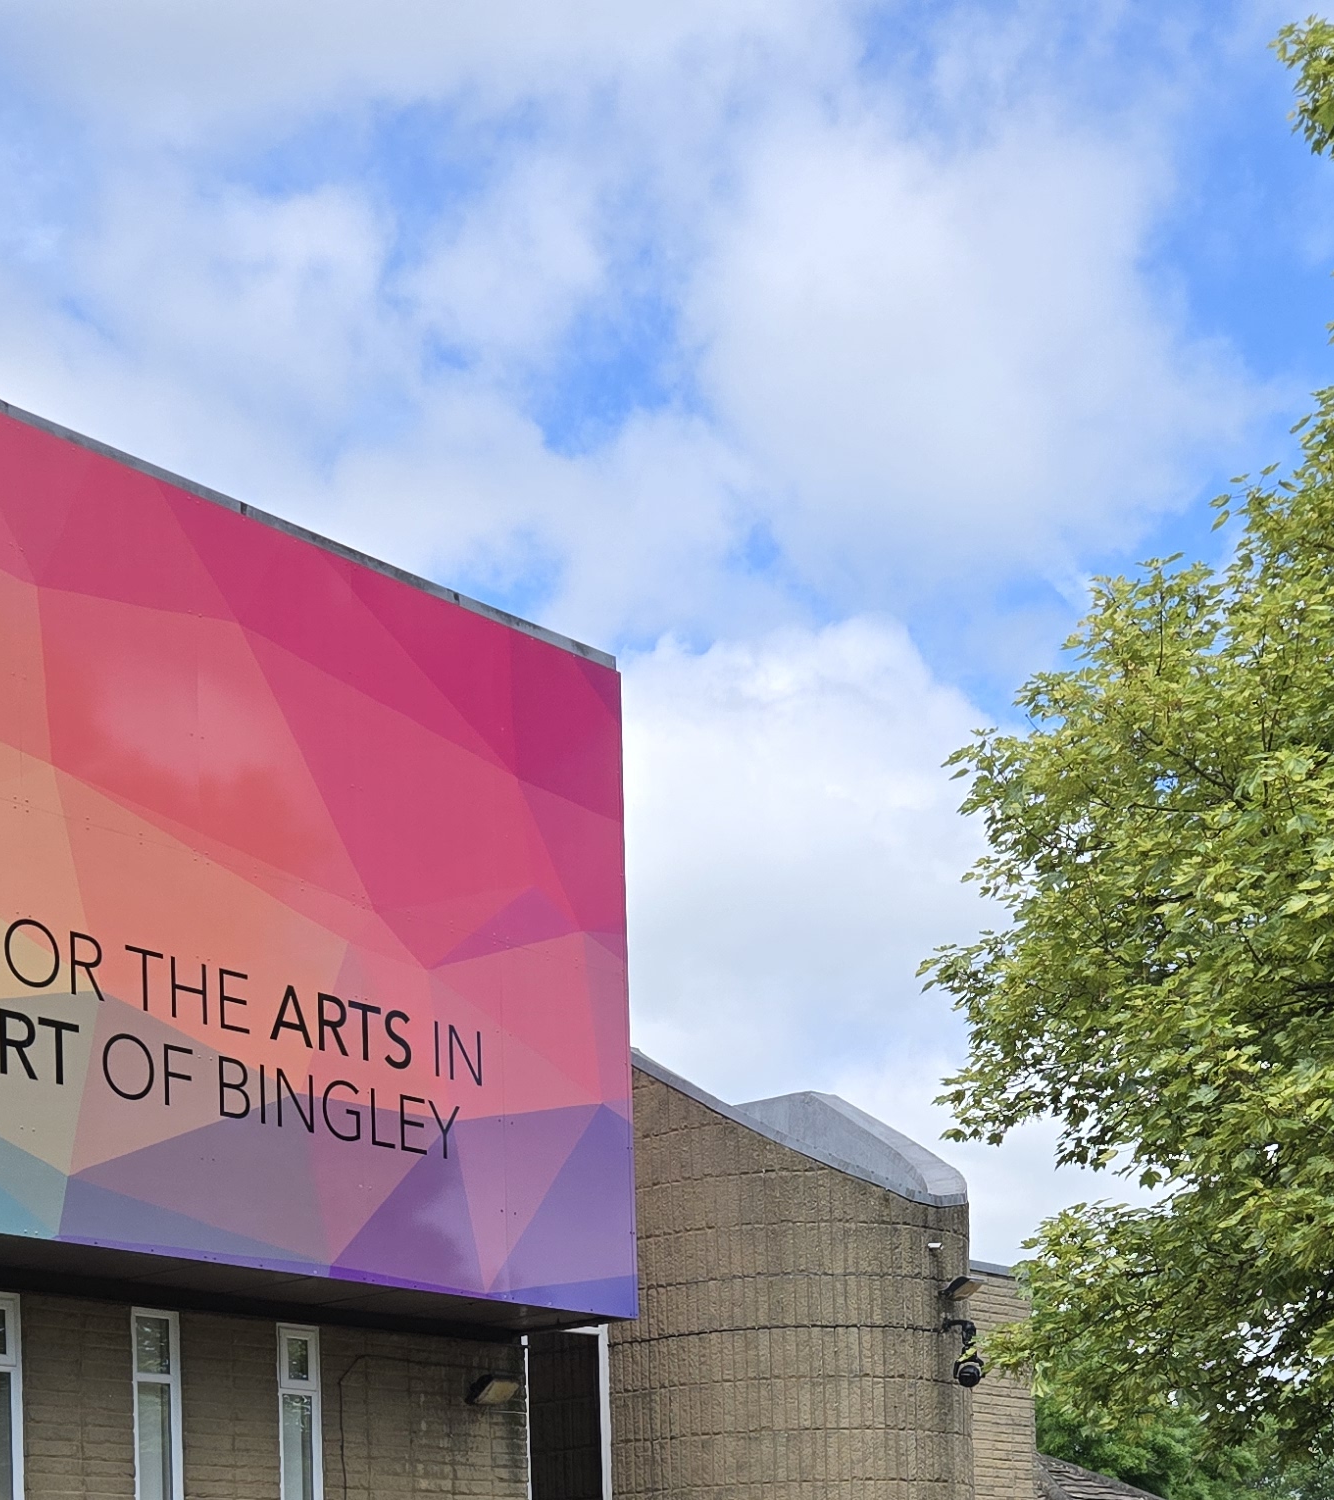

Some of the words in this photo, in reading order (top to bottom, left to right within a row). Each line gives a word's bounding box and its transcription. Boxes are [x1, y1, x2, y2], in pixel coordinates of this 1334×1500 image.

[125, 945, 250, 1036] THE
[270, 985, 412, 1071] ARTS
[434, 1022, 484, 1087] IN
[102, 1033, 193, 1107] OF
[218, 1058, 460, 1161] BINGLEY
